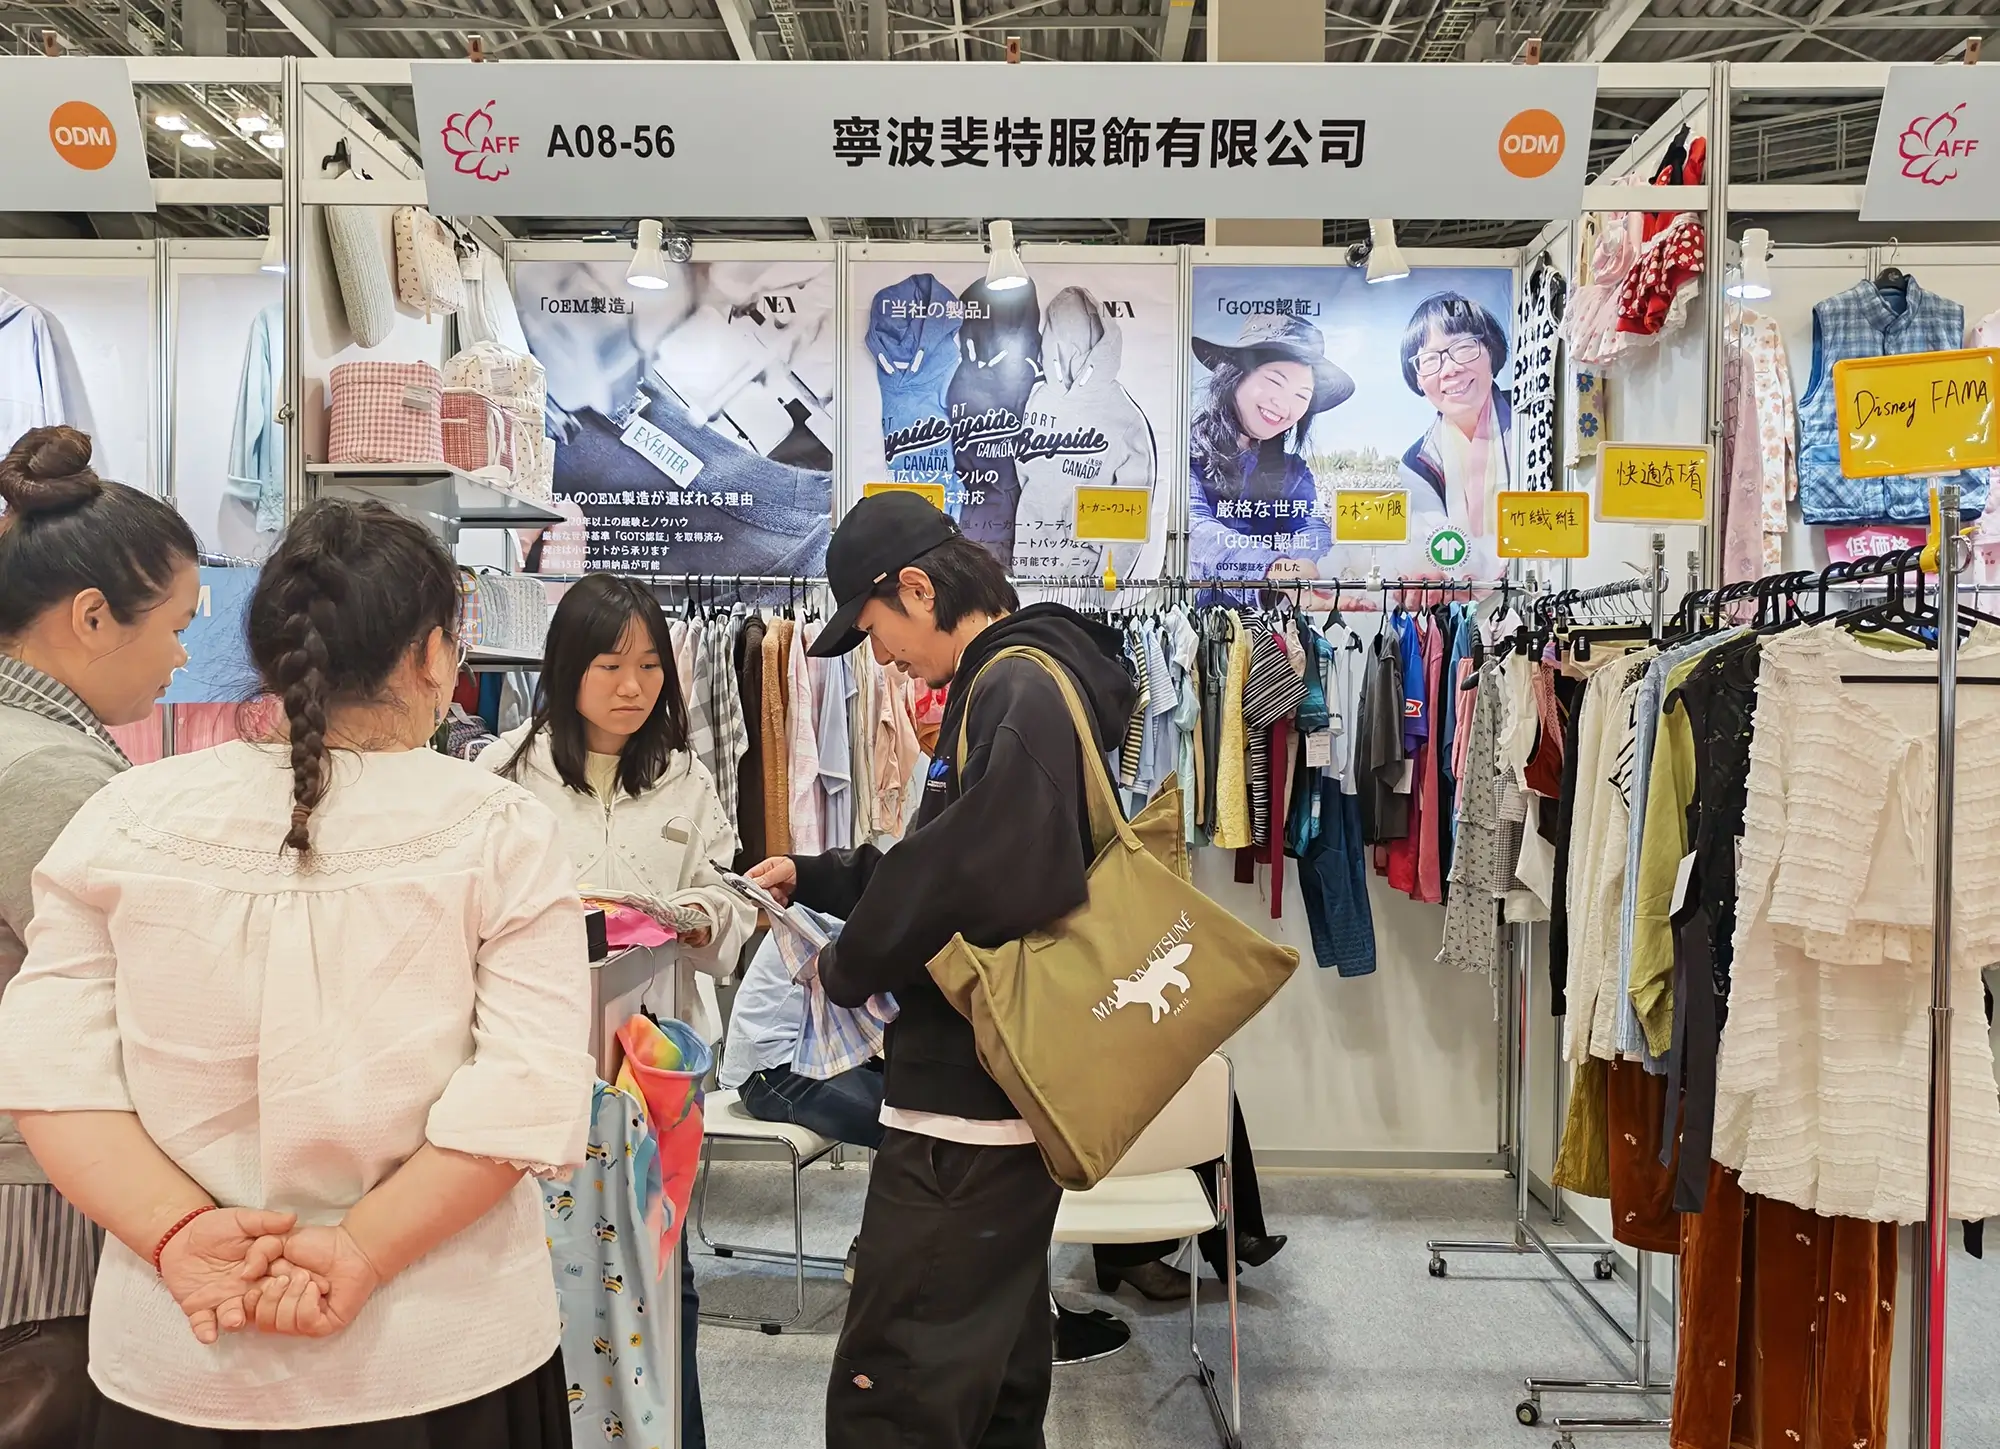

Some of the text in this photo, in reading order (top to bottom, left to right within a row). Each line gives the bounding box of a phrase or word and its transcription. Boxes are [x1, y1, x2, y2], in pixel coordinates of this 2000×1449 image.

[55, 127, 111, 146] ODM
[480, 136, 520, 153] AFF
[547, 124, 675, 159] A08-56
[832, 116, 1366, 169] 寧波斐特服飾有限公司
[1503, 134, 1559, 154] ODM
[1934, 140, 1979, 157] AFF
[880, 300, 991, 319] 「当社の製品」
[1216, 298, 1322, 317] 「GOTS認証」
[1854, 390, 1917, 430] Disney
[633, 426, 689, 476] EXFATTER
[1012, 427, 1109, 465] Bayside
[903, 455, 948, 472] CANADA
[551, 491, 753, 507] EAのOEM製造が選ばれる理由
[1173, 997, 1190, 1017] PARIS
